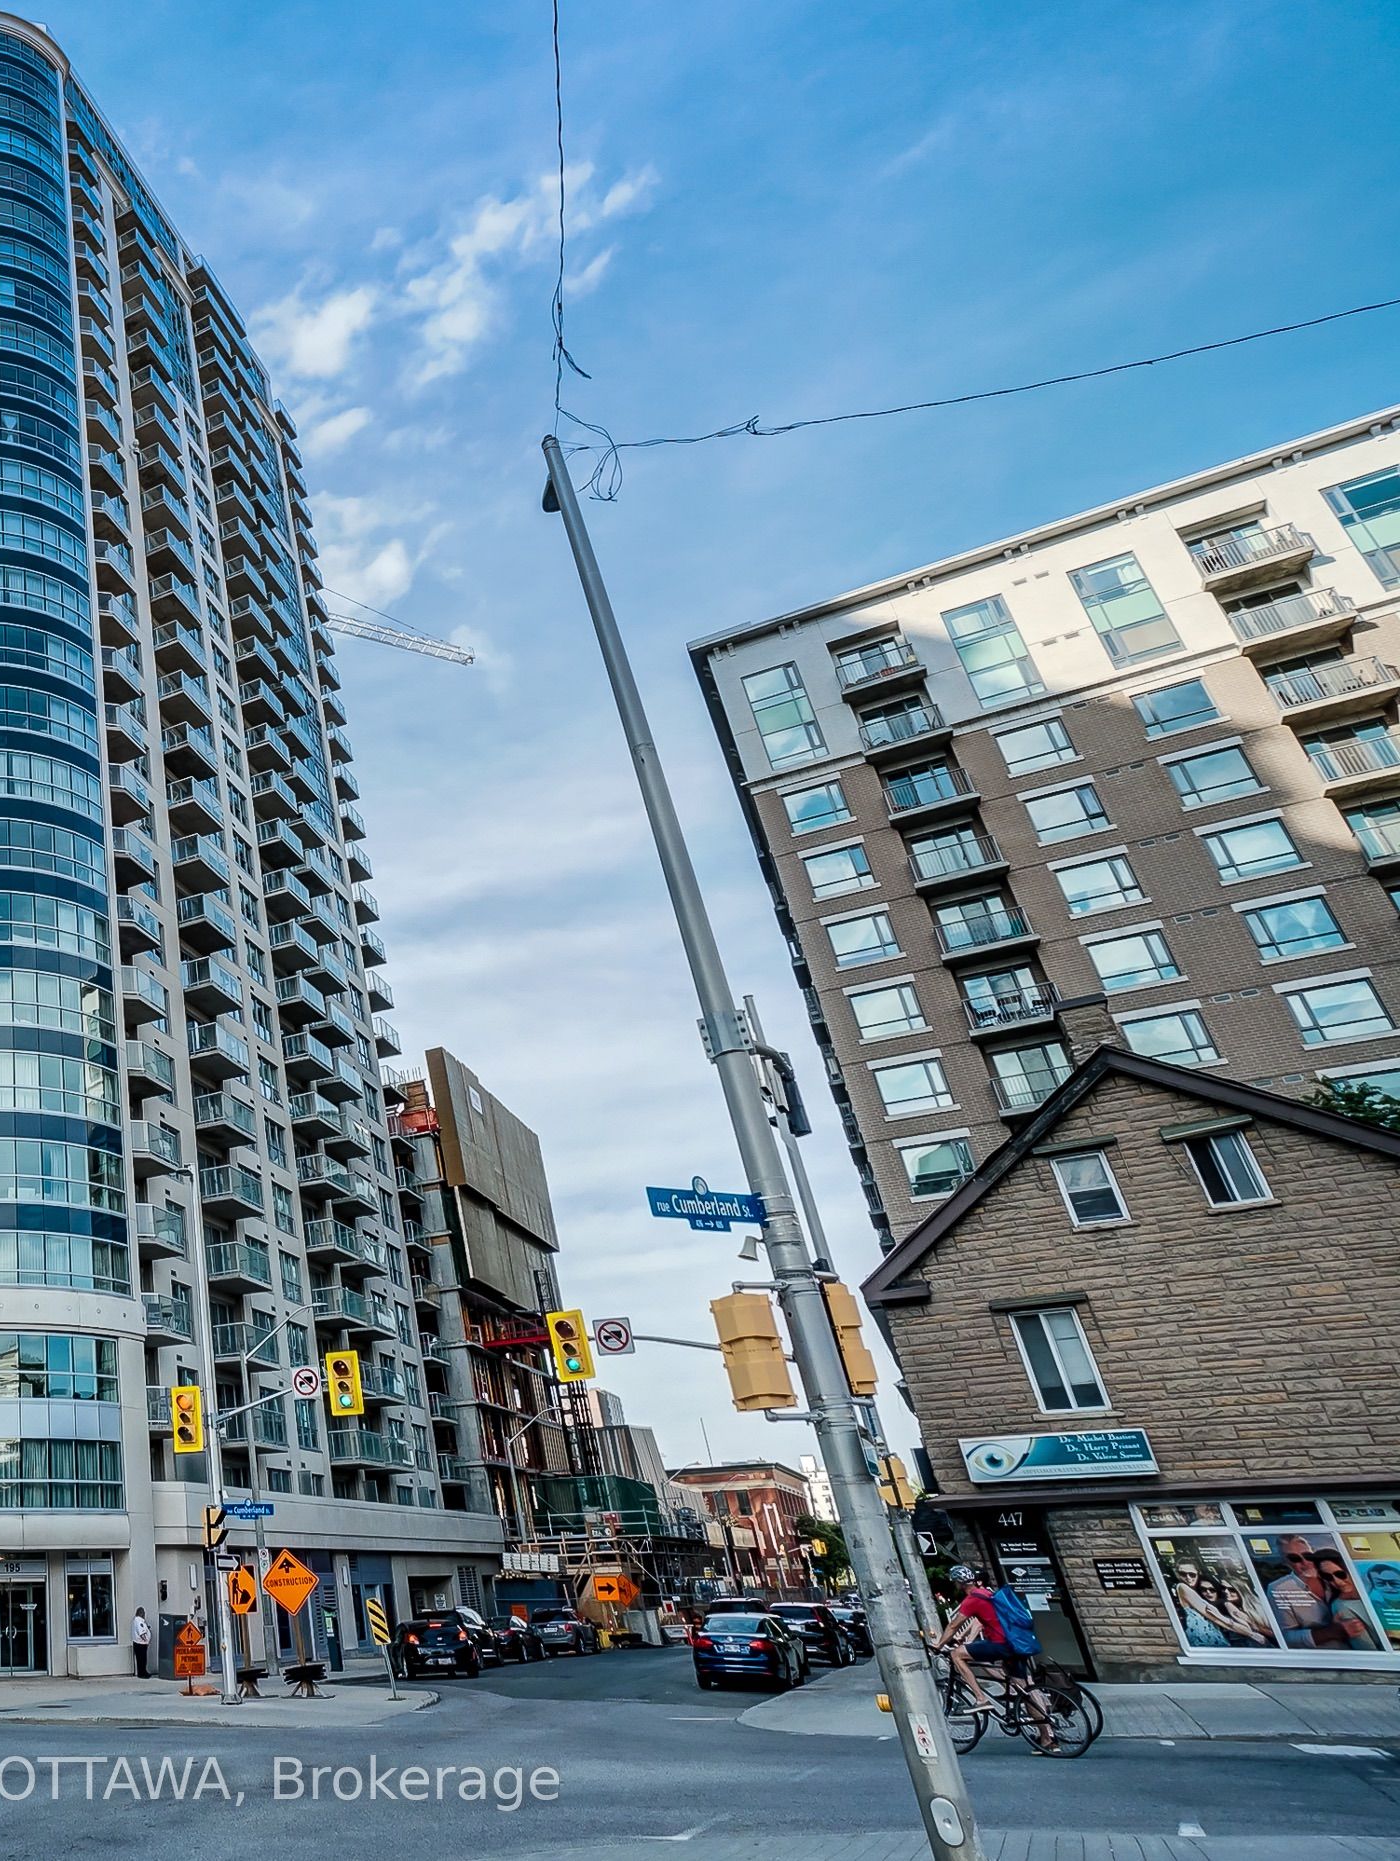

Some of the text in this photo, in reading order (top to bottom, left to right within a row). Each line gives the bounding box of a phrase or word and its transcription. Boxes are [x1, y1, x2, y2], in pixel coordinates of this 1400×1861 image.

[656, 1194, 754, 1218] rue Cumberland St.
[1077, 1434, 1106, 1442] Michel
[1108, 1433, 1136, 1441] Bastien
[1083, 1443, 1108, 1453] Harry
[234, 1505, 265, 1514] Cumberland
[998, 1512, 1023, 1526] 447
[4, 1563, 21, 1572] 195
[265, 1576, 313, 1588] CONSTRUCTION
